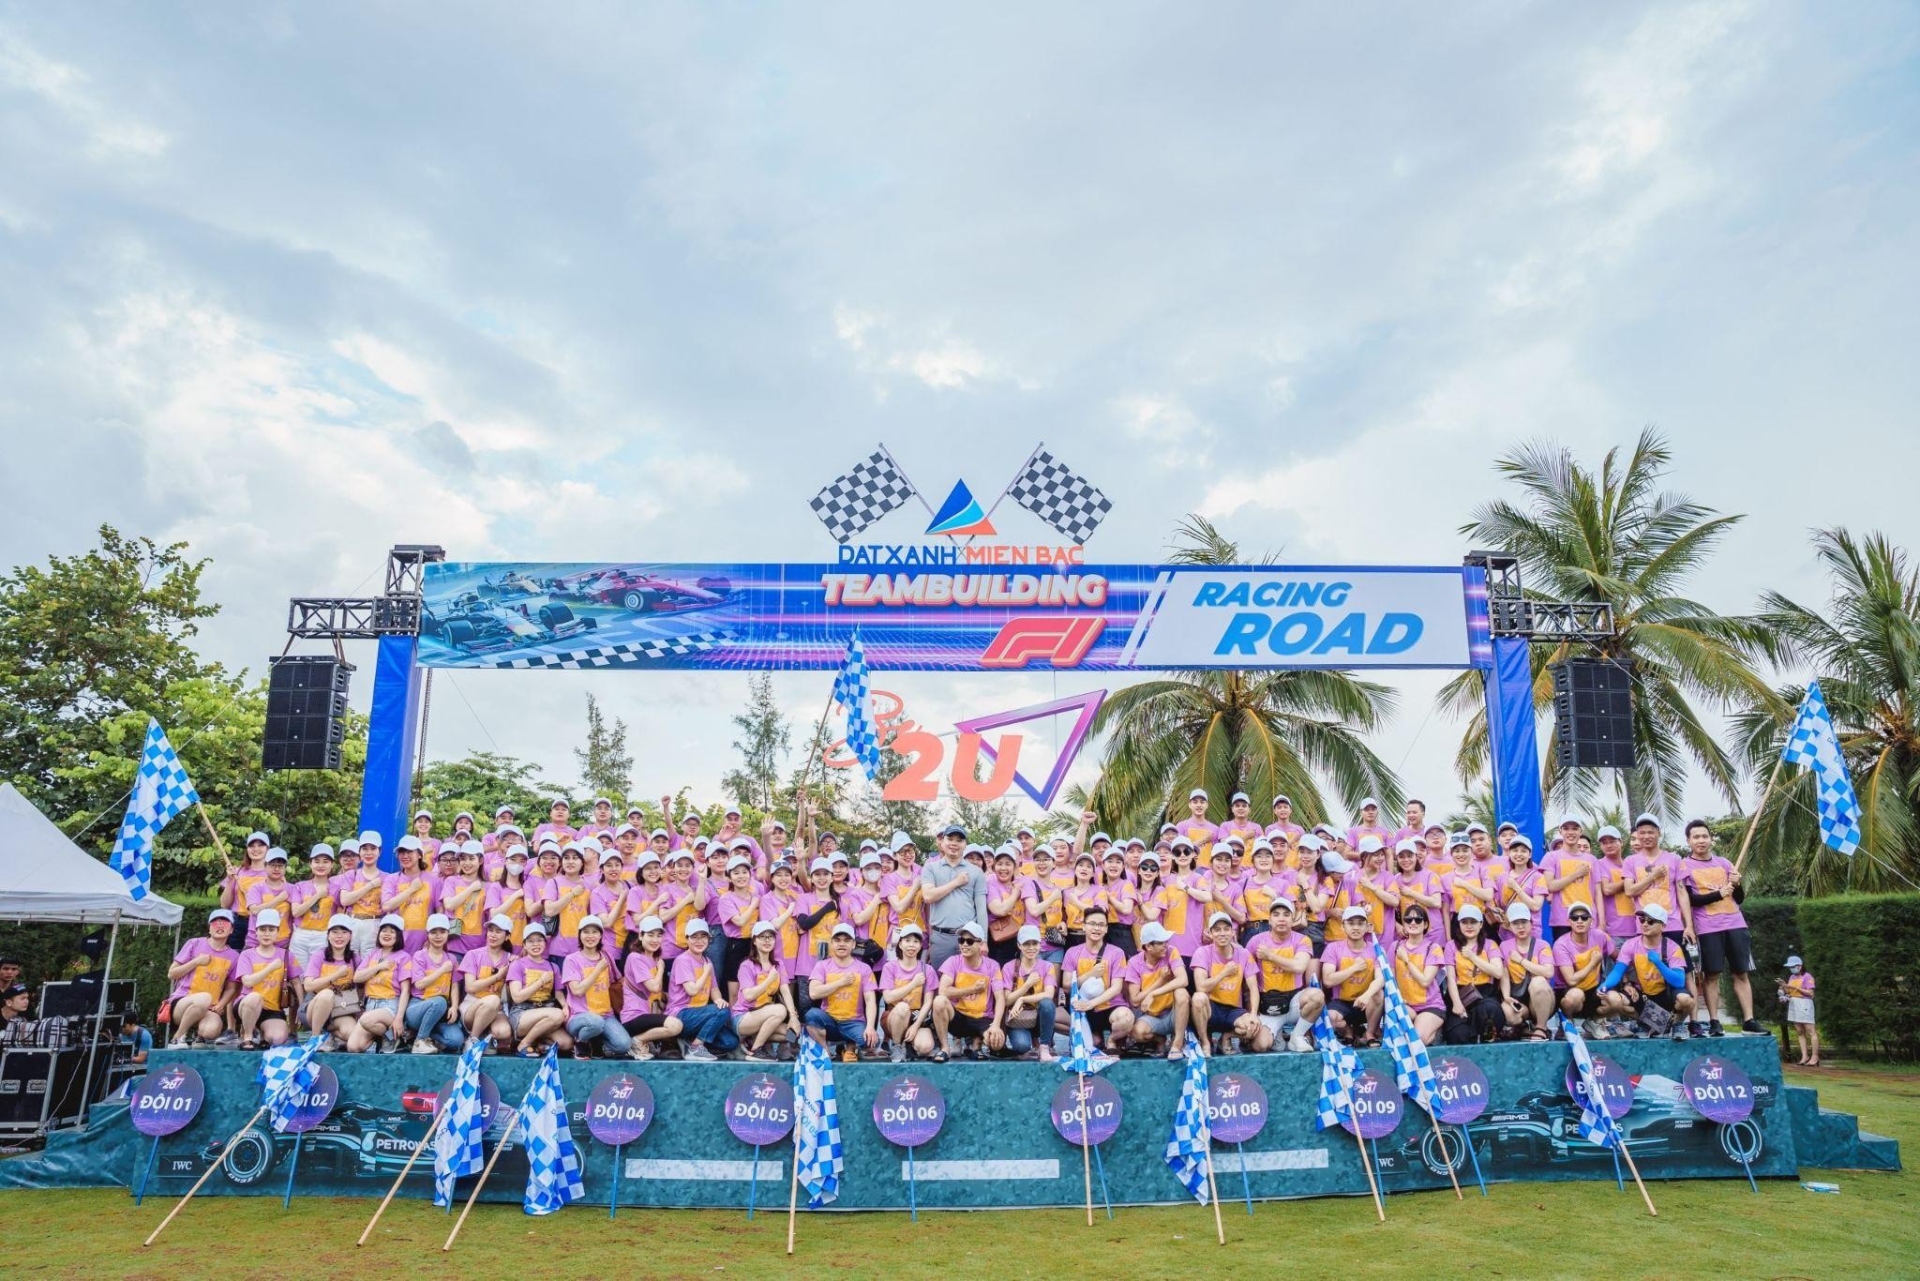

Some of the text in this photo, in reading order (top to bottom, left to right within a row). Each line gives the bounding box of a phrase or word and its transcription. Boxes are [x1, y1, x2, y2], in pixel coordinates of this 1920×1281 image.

[966, 545, 1028, 565] MIEN
[821, 573, 1109, 606] TEAMBUILDING
[1192, 581, 1353, 607] RACING
[1213, 612, 1424, 655] ROAD
[882, 731, 1023, 802] 2U
[1461, 1082, 1482, 1097] 10
[1576, 1081, 1604, 1096] ĐI
[1607, 1084, 1625, 1097] 11
[1694, 1084, 1748, 1103] ĐỘI 12
[140, 1093, 192, 1115] ĐỘI 01
[311, 1093, 329, 1107] 02
[1376, 1100, 1396, 1114] 09
[594, 1102, 645, 1123] ĐỘI 04
[734, 1102, 788, 1122] ĐỘI 05
[882, 1105, 938, 1125] ĐỘI 06
[1061, 1101, 1114, 1125] ĐỘI 07
[1209, 1101, 1260, 1122] ĐỘI 08
[172, 1160, 193, 1171] IWC
[1378, 1157, 1395, 1167] WC
